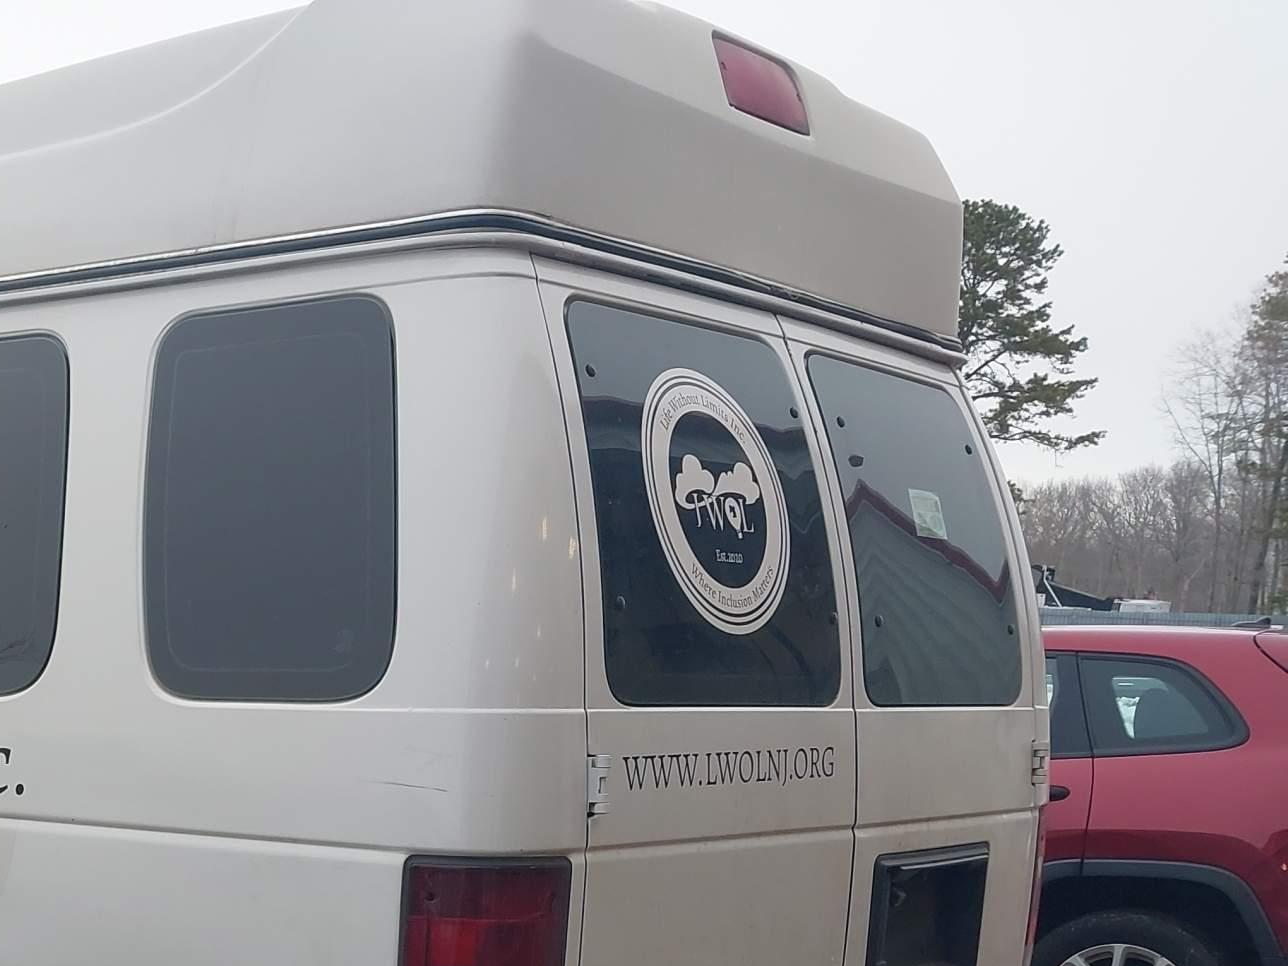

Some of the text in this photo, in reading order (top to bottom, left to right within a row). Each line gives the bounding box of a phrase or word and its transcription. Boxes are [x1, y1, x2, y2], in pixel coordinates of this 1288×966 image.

[660, 407, 673, 432] Life
[700, 394, 729, 422] Limits
[731, 417, 746, 444] Inc.
[692, 563, 774, 609] Where Inclusion Matters
[621, 746, 835, 792] WWW.LWOLNJ.ORG
